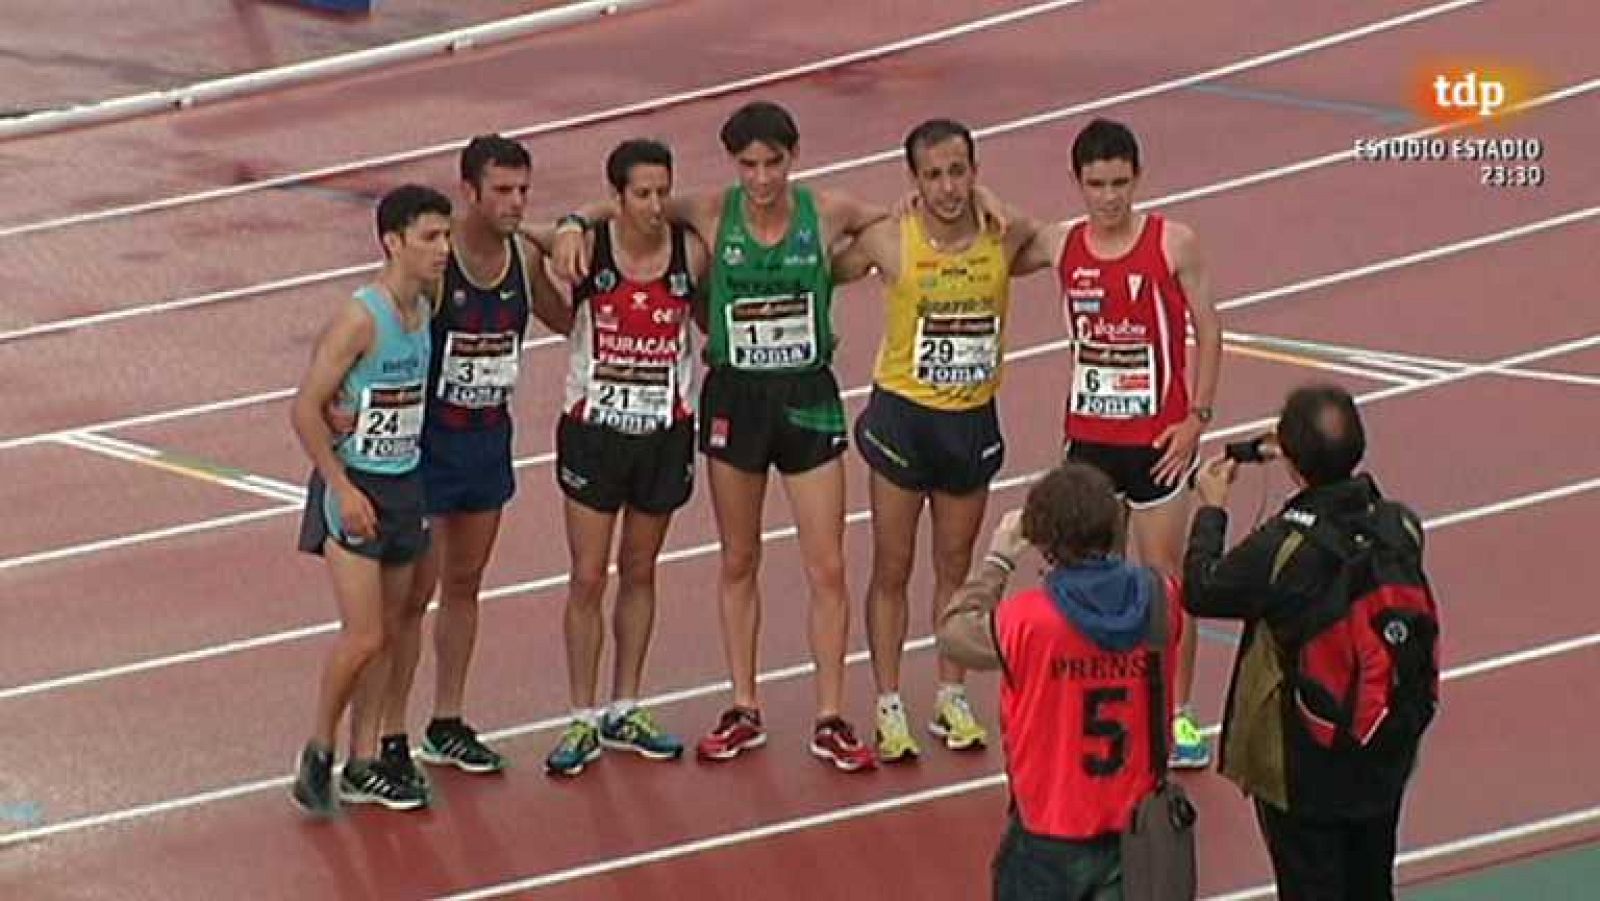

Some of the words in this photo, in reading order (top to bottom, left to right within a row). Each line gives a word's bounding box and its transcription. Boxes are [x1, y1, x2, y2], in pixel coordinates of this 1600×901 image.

[745, 325, 757, 345] 1
[920, 340, 954, 364] 29
[458, 362, 474, 384] 3
[1085, 369, 1101, 393] 6
[599, 385, 630, 409] 21
[366, 410, 399, 435] 24
[1050, 653, 1149, 680] PRENS
[1081, 687, 1128, 777] 5
